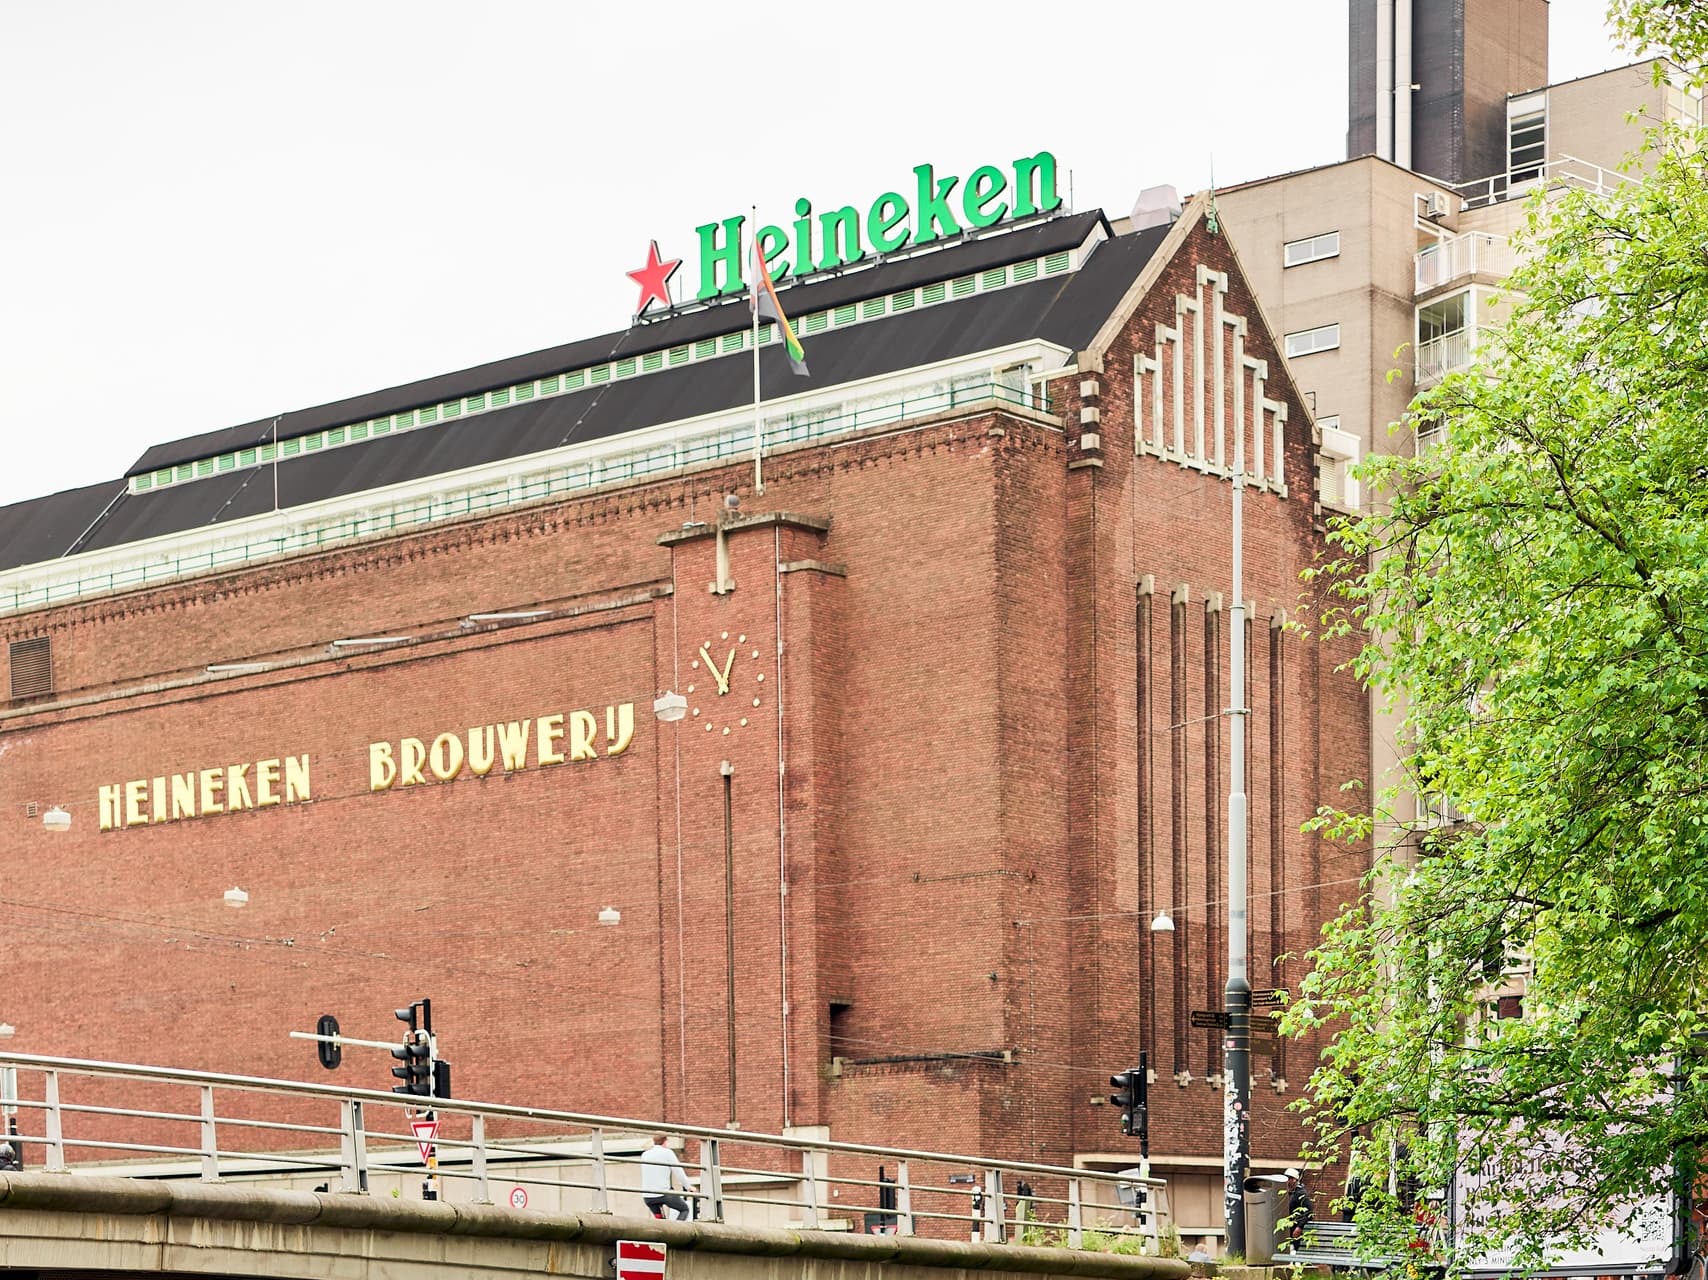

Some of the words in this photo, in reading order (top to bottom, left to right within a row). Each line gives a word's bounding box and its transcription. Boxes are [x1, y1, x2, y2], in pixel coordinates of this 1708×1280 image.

[695, 151, 1064, 300] Heineken
[99, 753, 311, 831] HEINEKEN
[369, 702, 634, 791] BROUWERIJ
[514, 1194, 525, 1204] 30
